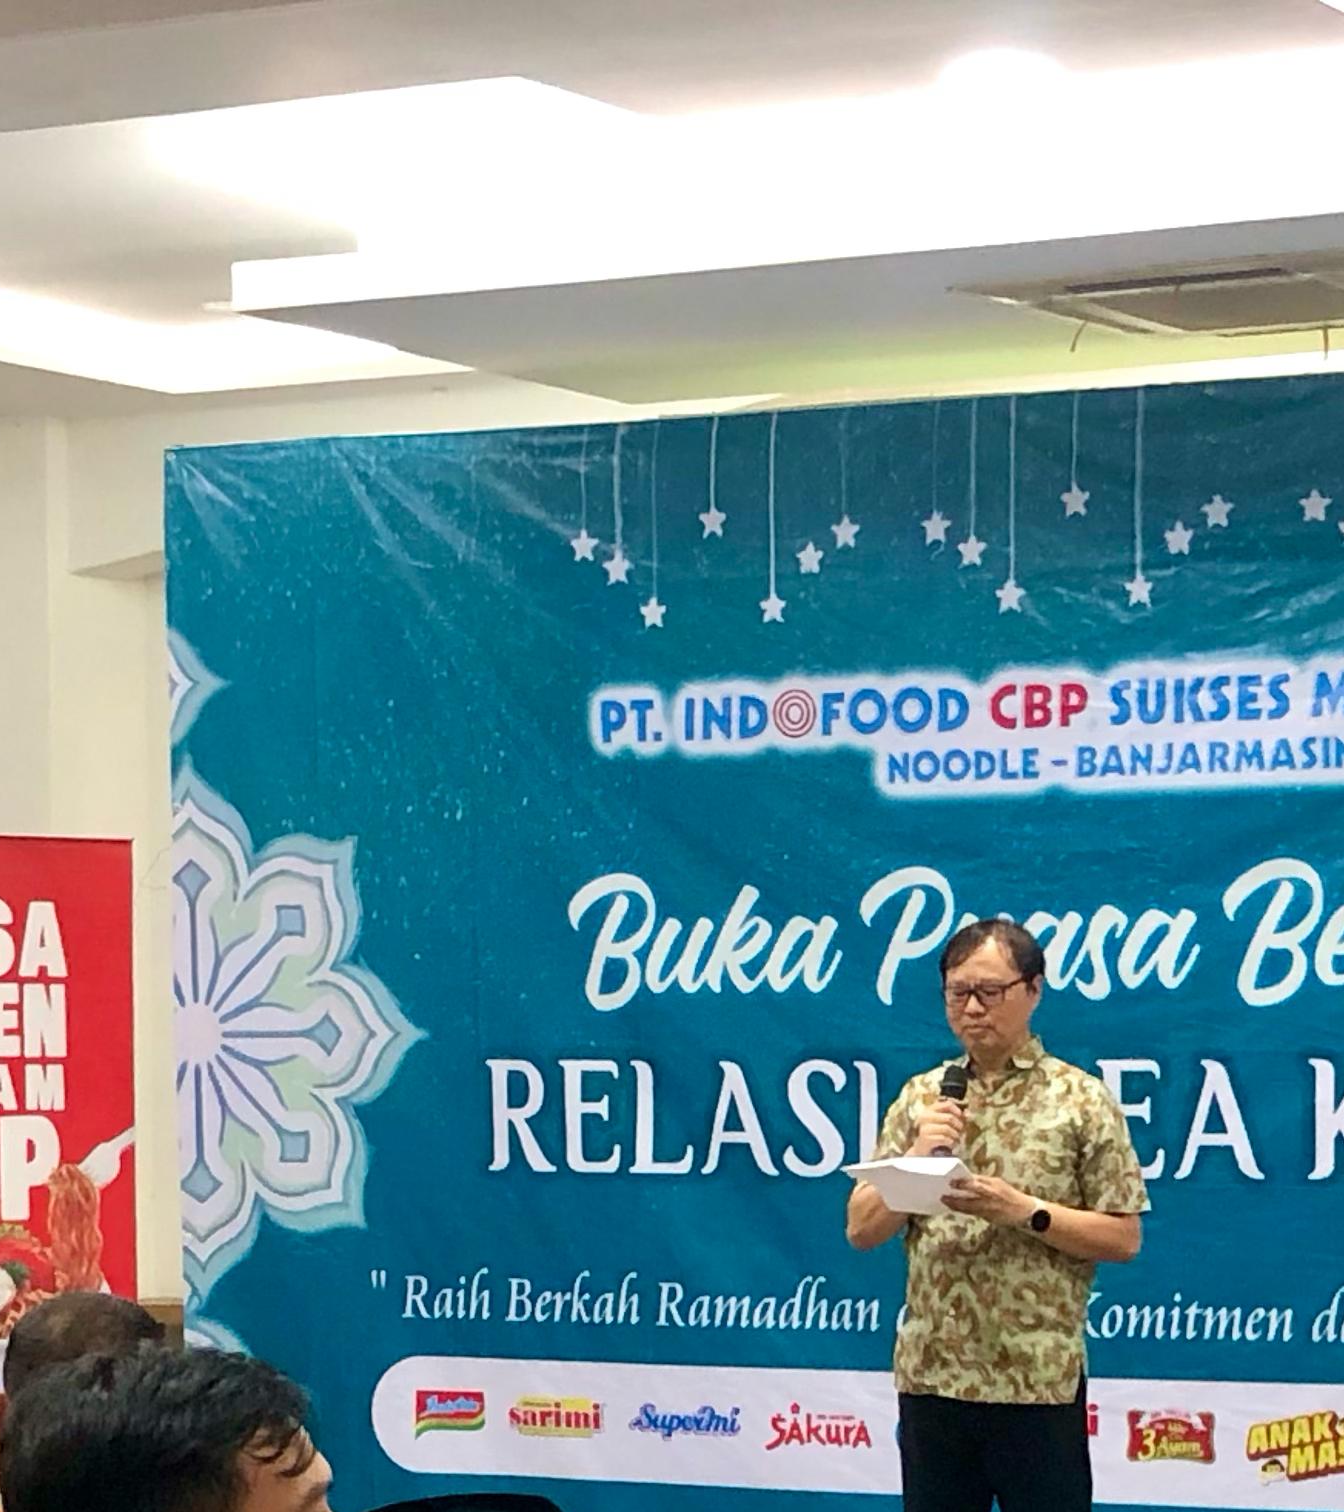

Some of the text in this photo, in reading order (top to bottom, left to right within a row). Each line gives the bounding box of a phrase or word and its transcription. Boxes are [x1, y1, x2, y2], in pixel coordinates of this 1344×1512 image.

[600, 699, 663, 743] PT.
[684, 686, 970, 741] INDOFOOD
[988, 682, 1089, 731] CBP
[1109, 672, 1291, 726] SUKSES
[888, 747, 1040, 784] NOODLE
[568, 872, 844, 1012] Buka
[859, 865, 1201, 1007] Pasa
[484, 1057, 881, 1178] RELASI
[1095, 1055, 1265, 1181] EA
[401, 1267, 490, 1321] Raih
[504, 1268, 641, 1325] Berkah
[655, 1276, 881, 1333] Ramadhan
[1250, 1411, 1334, 1453] ANAK
